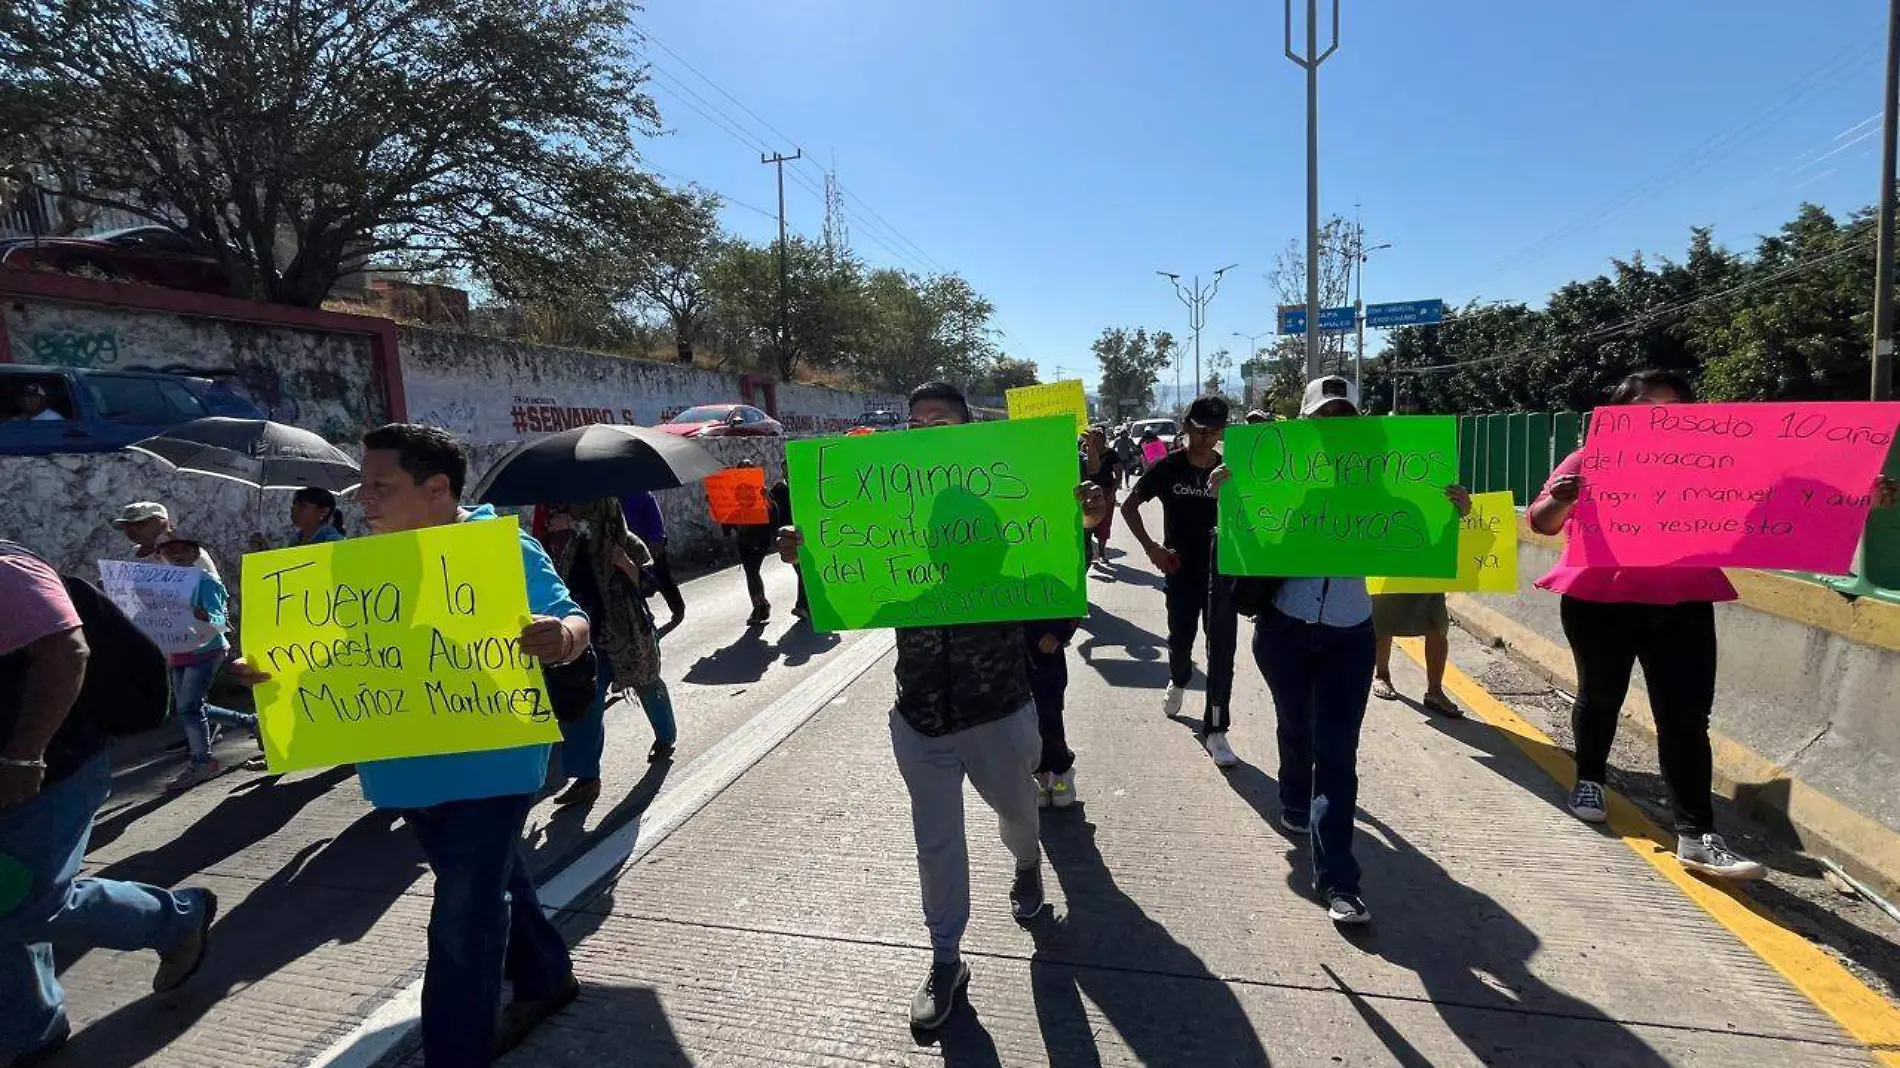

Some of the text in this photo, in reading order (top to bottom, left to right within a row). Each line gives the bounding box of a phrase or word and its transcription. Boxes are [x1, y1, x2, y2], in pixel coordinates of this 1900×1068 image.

[1650, 405, 1754, 438] Pasado
[1777, 411, 1827, 439] 10
[1249, 425, 1453, 488] Queremos
[1582, 448, 1623, 470] del
[817, 443, 1030, 521] Exigimos
[819, 513, 1050, 551] Escrituracion
[1235, 494, 1427, 552] Escrituras
[1659, 515, 1795, 536] respuesta
[822, 555, 867, 585] del
[262, 555, 477, 629] Fuera la
[267, 632, 404, 674] maestra
[298, 680, 553, 724] Muñoz Martinez
